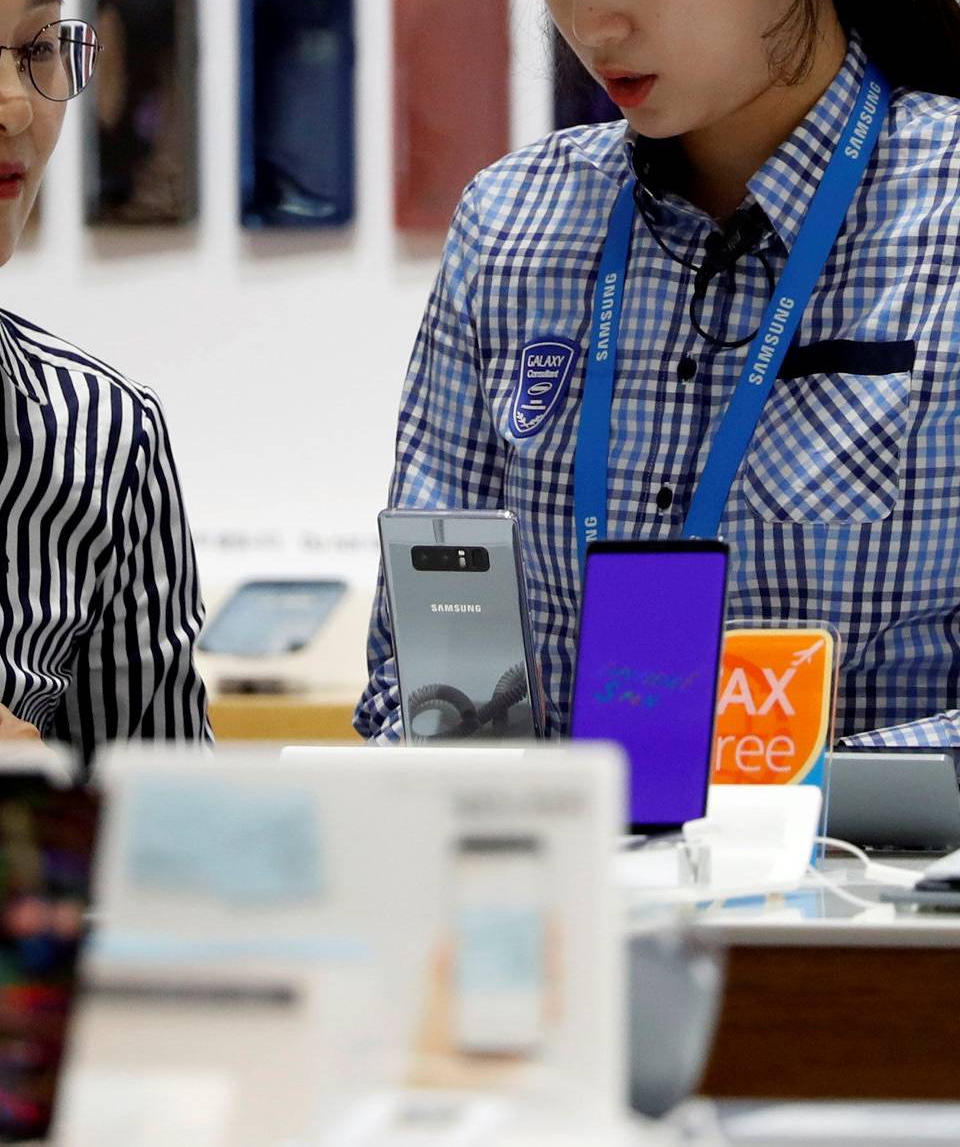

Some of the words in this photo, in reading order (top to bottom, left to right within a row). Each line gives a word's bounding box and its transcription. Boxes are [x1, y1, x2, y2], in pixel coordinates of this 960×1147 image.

[844, 81, 882, 159] SAMSUNG
[596, 272, 618, 362] SAMSUNG
[748, 296, 795, 385] SAMSUNG
[527, 354, 565, 367] GALAXY
[431, 604, 481, 613] SAMSUNG
[716, 667, 797, 715] AX
[715, 734, 796, 772] ree
